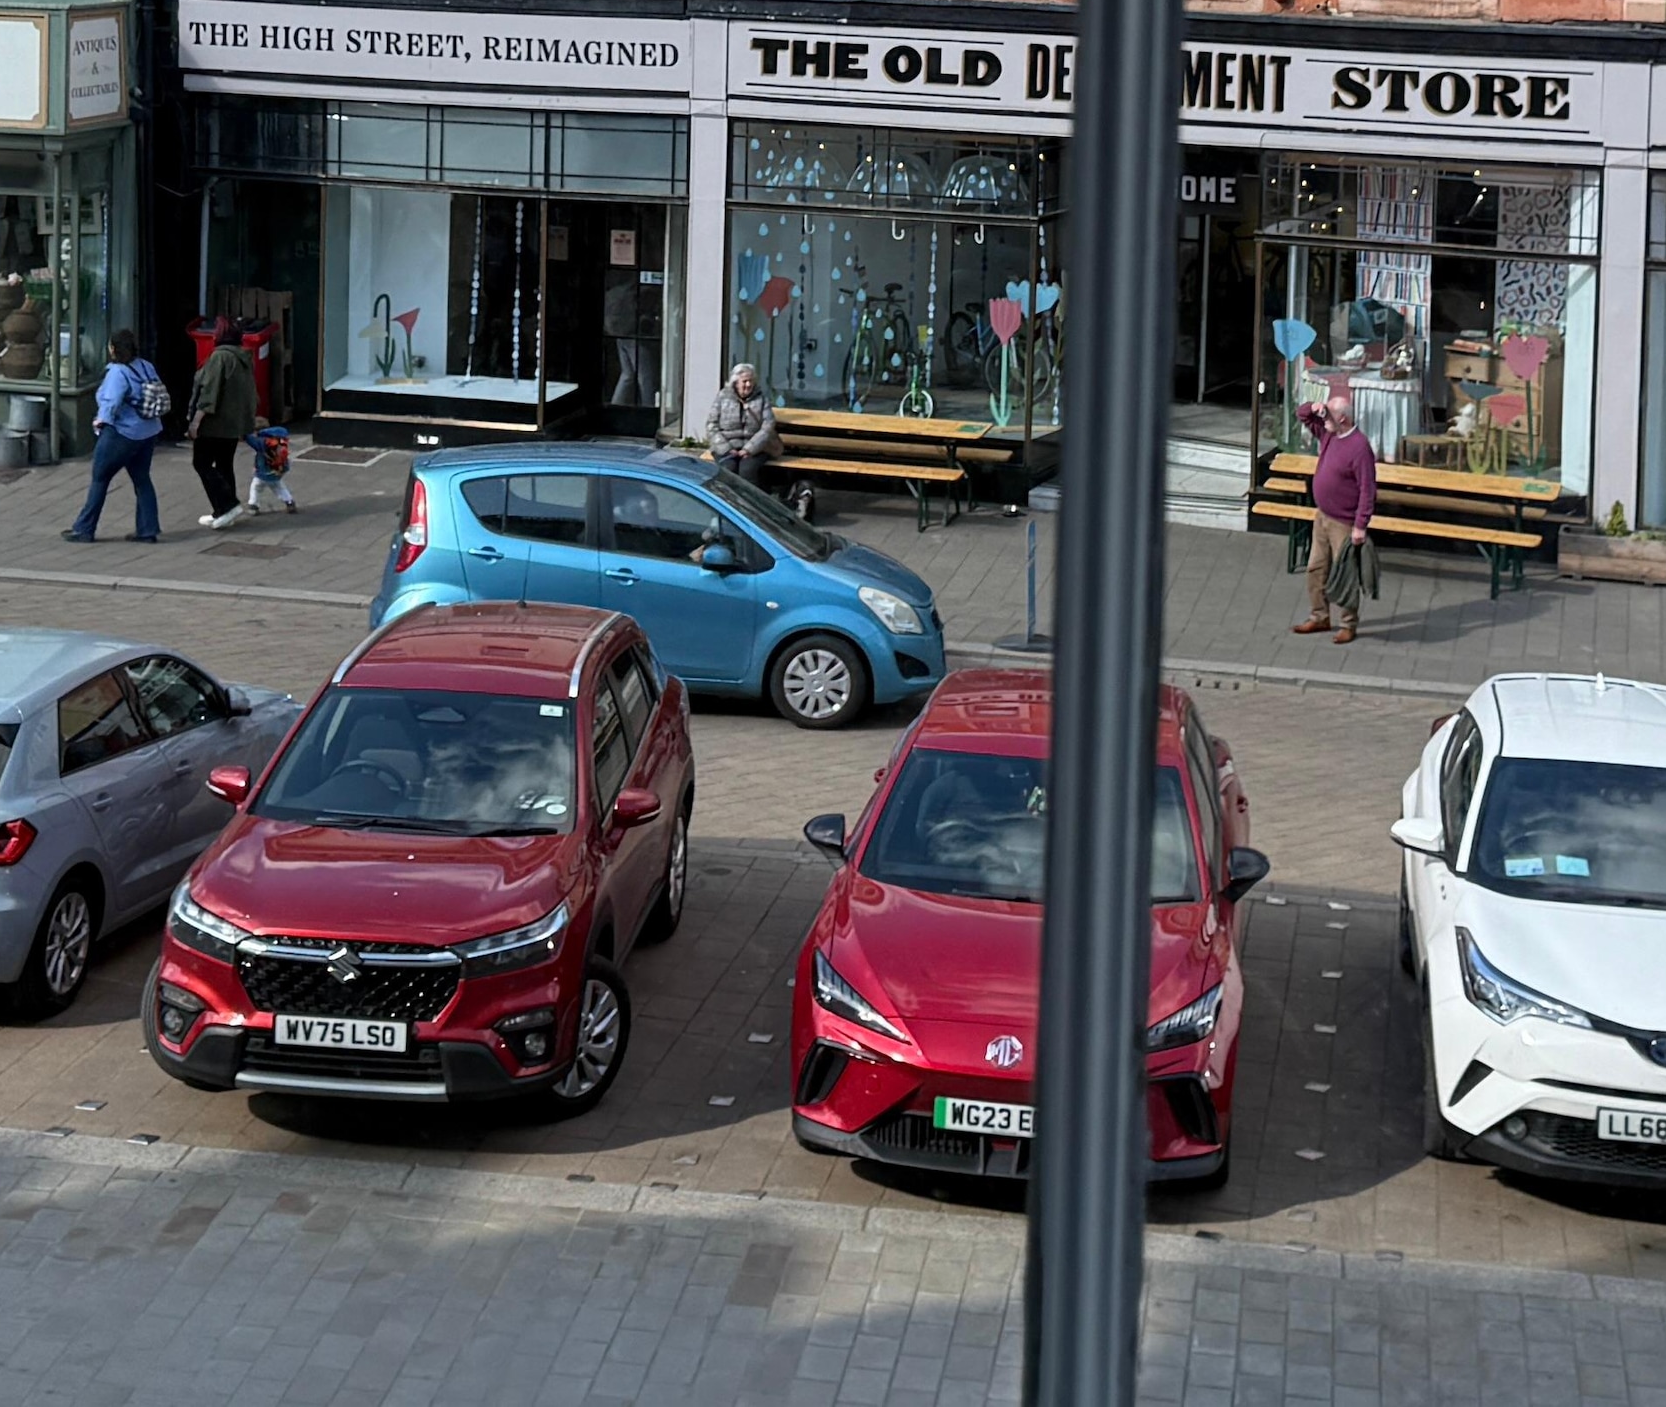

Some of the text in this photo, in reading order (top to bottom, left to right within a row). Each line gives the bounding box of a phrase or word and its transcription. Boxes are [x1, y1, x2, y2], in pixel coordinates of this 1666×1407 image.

[73, 36, 117, 56] ANTIQUES
[189, 21, 679, 67] THE HIGH STREET, REIMAGINED
[750, 37, 1570, 120] THE OLD DEMENT STORE
[286, 1019, 395, 1047] WV75 LSO
[951, 1102, 1012, 1130] WG23
